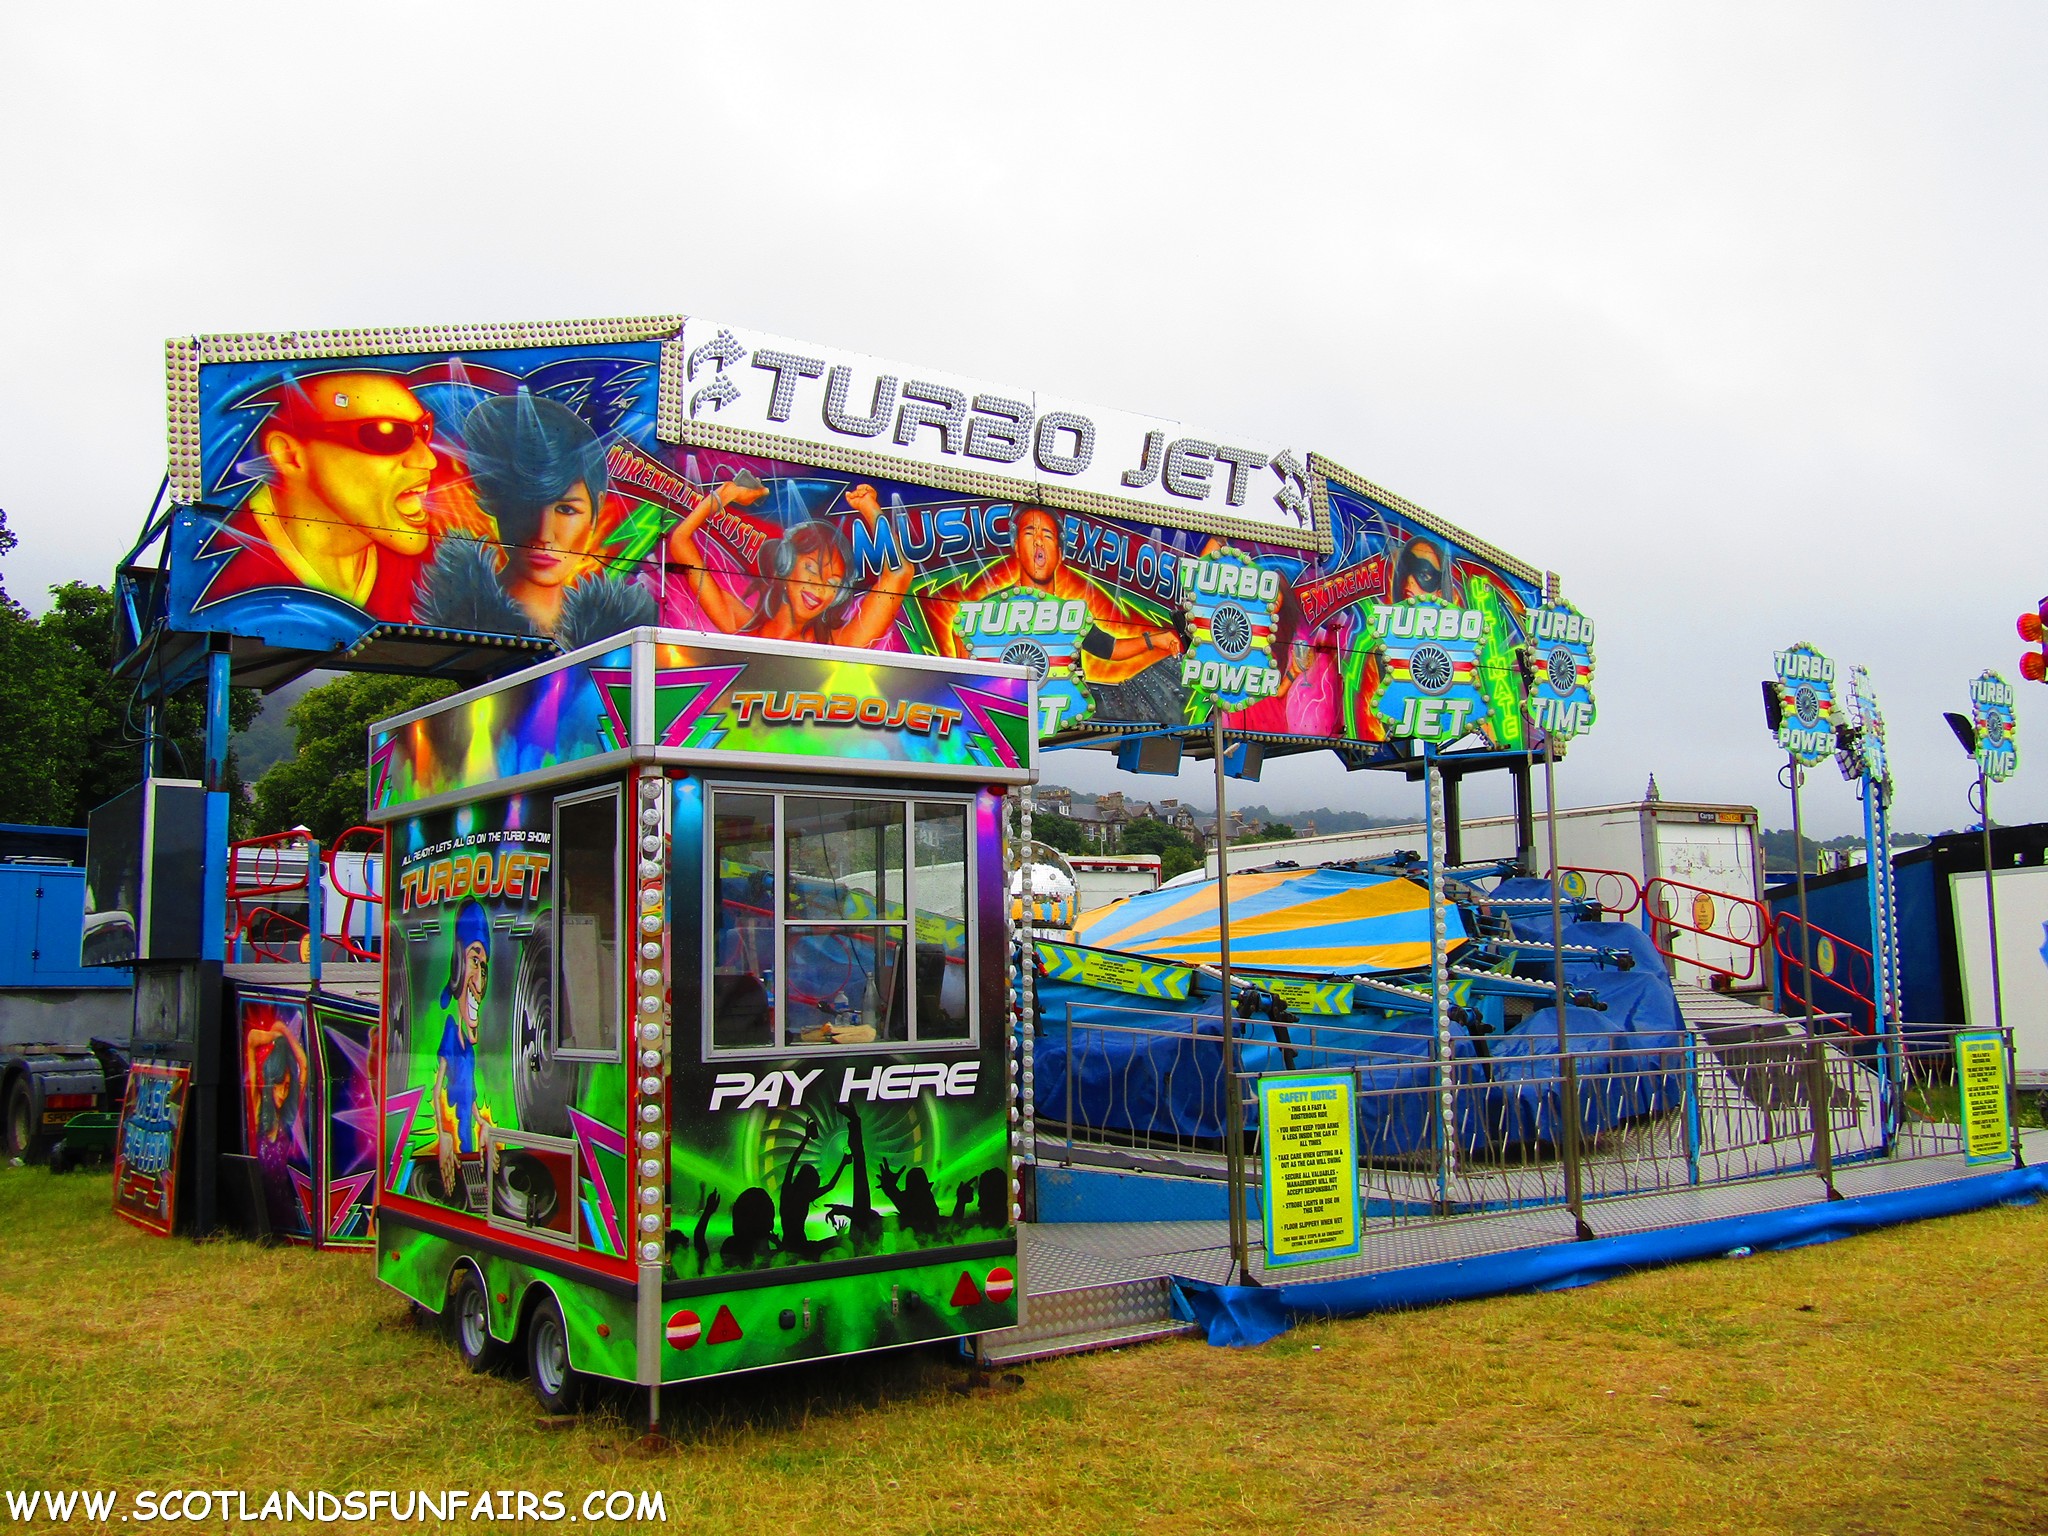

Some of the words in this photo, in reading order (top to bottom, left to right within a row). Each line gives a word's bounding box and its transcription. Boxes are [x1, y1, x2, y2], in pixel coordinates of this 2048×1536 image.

[752, 348, 1097, 476] TURBO
[1121, 428, 1272, 507] JET
[709, 507, 768, 564] RUSH
[851, 503, 1015, 583] MUSIC
[1180, 557, 1280, 603] TURBO
[1301, 561, 1381, 623] EXTREME
[960, 600, 1087, 634] TURBO
[1372, 604, 1484, 641] TURBO
[1525, 608, 1595, 646] TURBO
[1181, 658, 1281, 696] POWER
[1471, 578, 1518, 739] ULTIMATE
[1773, 651, 1834, 682] TURBO
[1969, 679, 2013, 705] TURBO
[731, 689, 962, 737] TURBOJET
[1395, 698, 1473, 739] JET
[1532, 697, 1594, 735] TIME
[1779, 727, 1837, 754] POWER
[1980, 750, 2015, 778] TIME
[402, 856, 412, 867] ALL
[413, 845, 435, 860] READY?
[453, 837, 465, 849] ALL
[466, 835, 475, 846] GO
[476, 833, 487, 844] ON
[488, 832, 501, 842] THE
[503, 831, 526, 842] TURBO
[527, 831, 551, 844] SHOW!
[400, 851, 551, 914] TURBOJET
[709, 1068, 824, 1111] PAY
[839, 1061, 981, 1103] HERE
[1279, 1092, 1308, 1103] SAFETY
[1311, 1089, 1337, 1101] NOTICE
[1287, 1188, 1303, 1196] ACCEPT
[1304, 1199, 1318, 1207] LIGHTS
